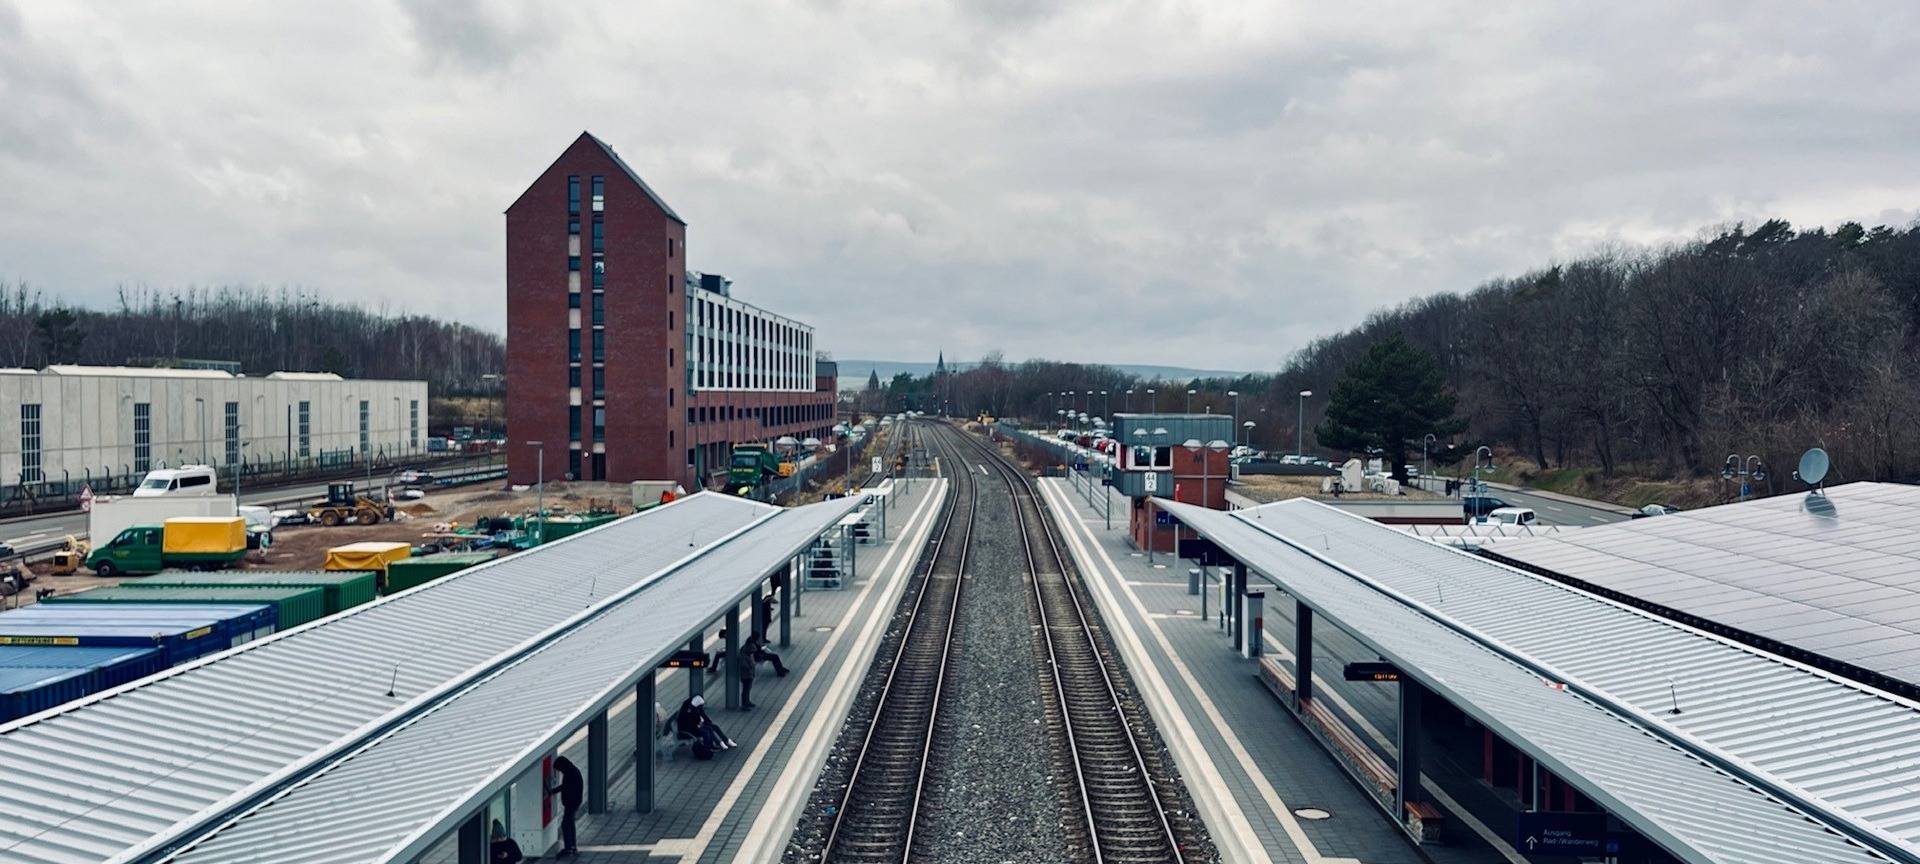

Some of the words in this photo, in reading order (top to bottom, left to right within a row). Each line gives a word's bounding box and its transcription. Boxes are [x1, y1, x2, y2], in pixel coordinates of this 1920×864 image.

[1148, 481, 1153, 489] 2
[1202, 552, 1207, 563] 1
[1543, 829, 1571, 837] Ausgang
